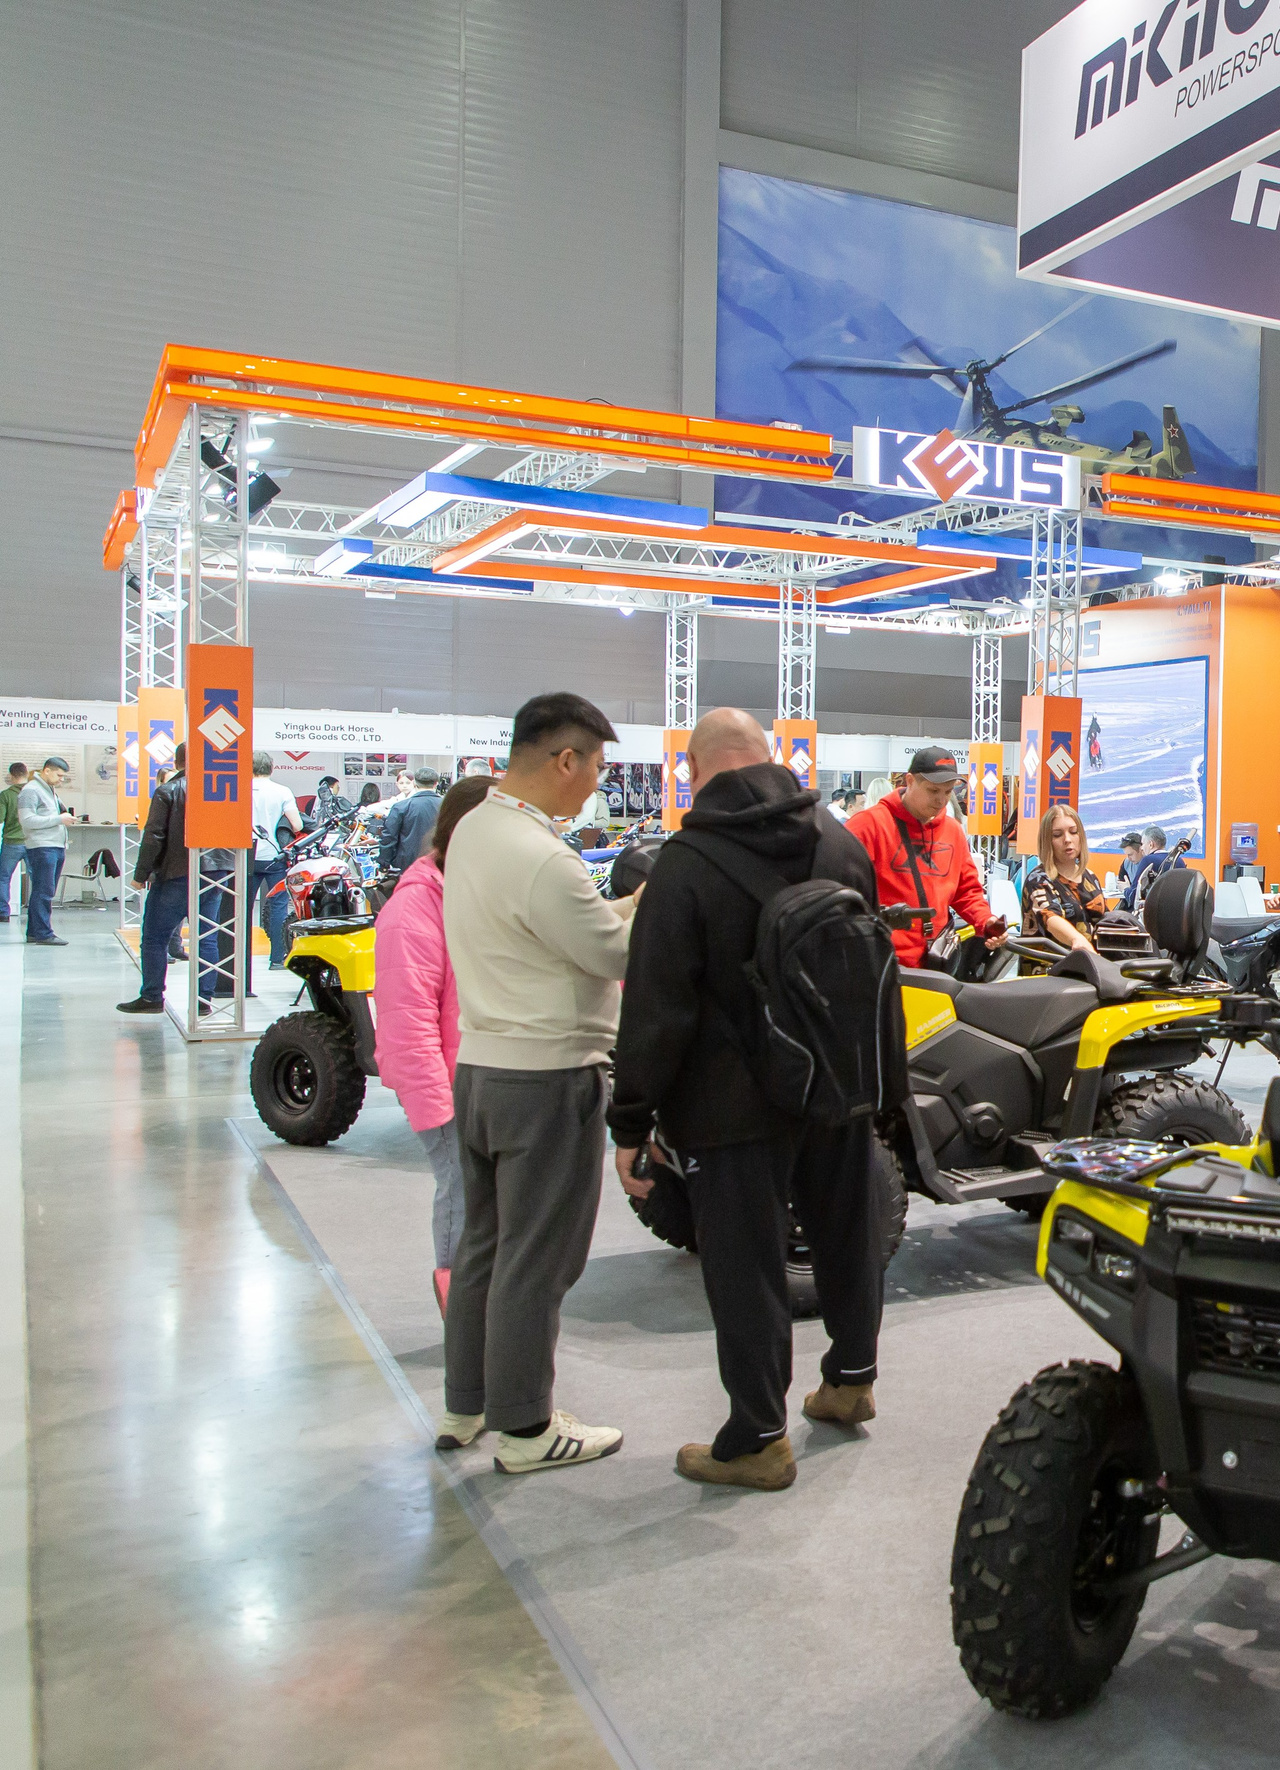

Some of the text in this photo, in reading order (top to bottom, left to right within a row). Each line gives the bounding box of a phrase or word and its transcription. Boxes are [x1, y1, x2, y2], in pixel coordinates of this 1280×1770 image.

[43, 711, 88, 722] Yameige
[39, 721, 87, 731] Electrical
[283, 722, 375, 733] Yingkou Dark Horse
[275, 732, 306, 742] Sports
[308, 732, 338, 741] Goods
